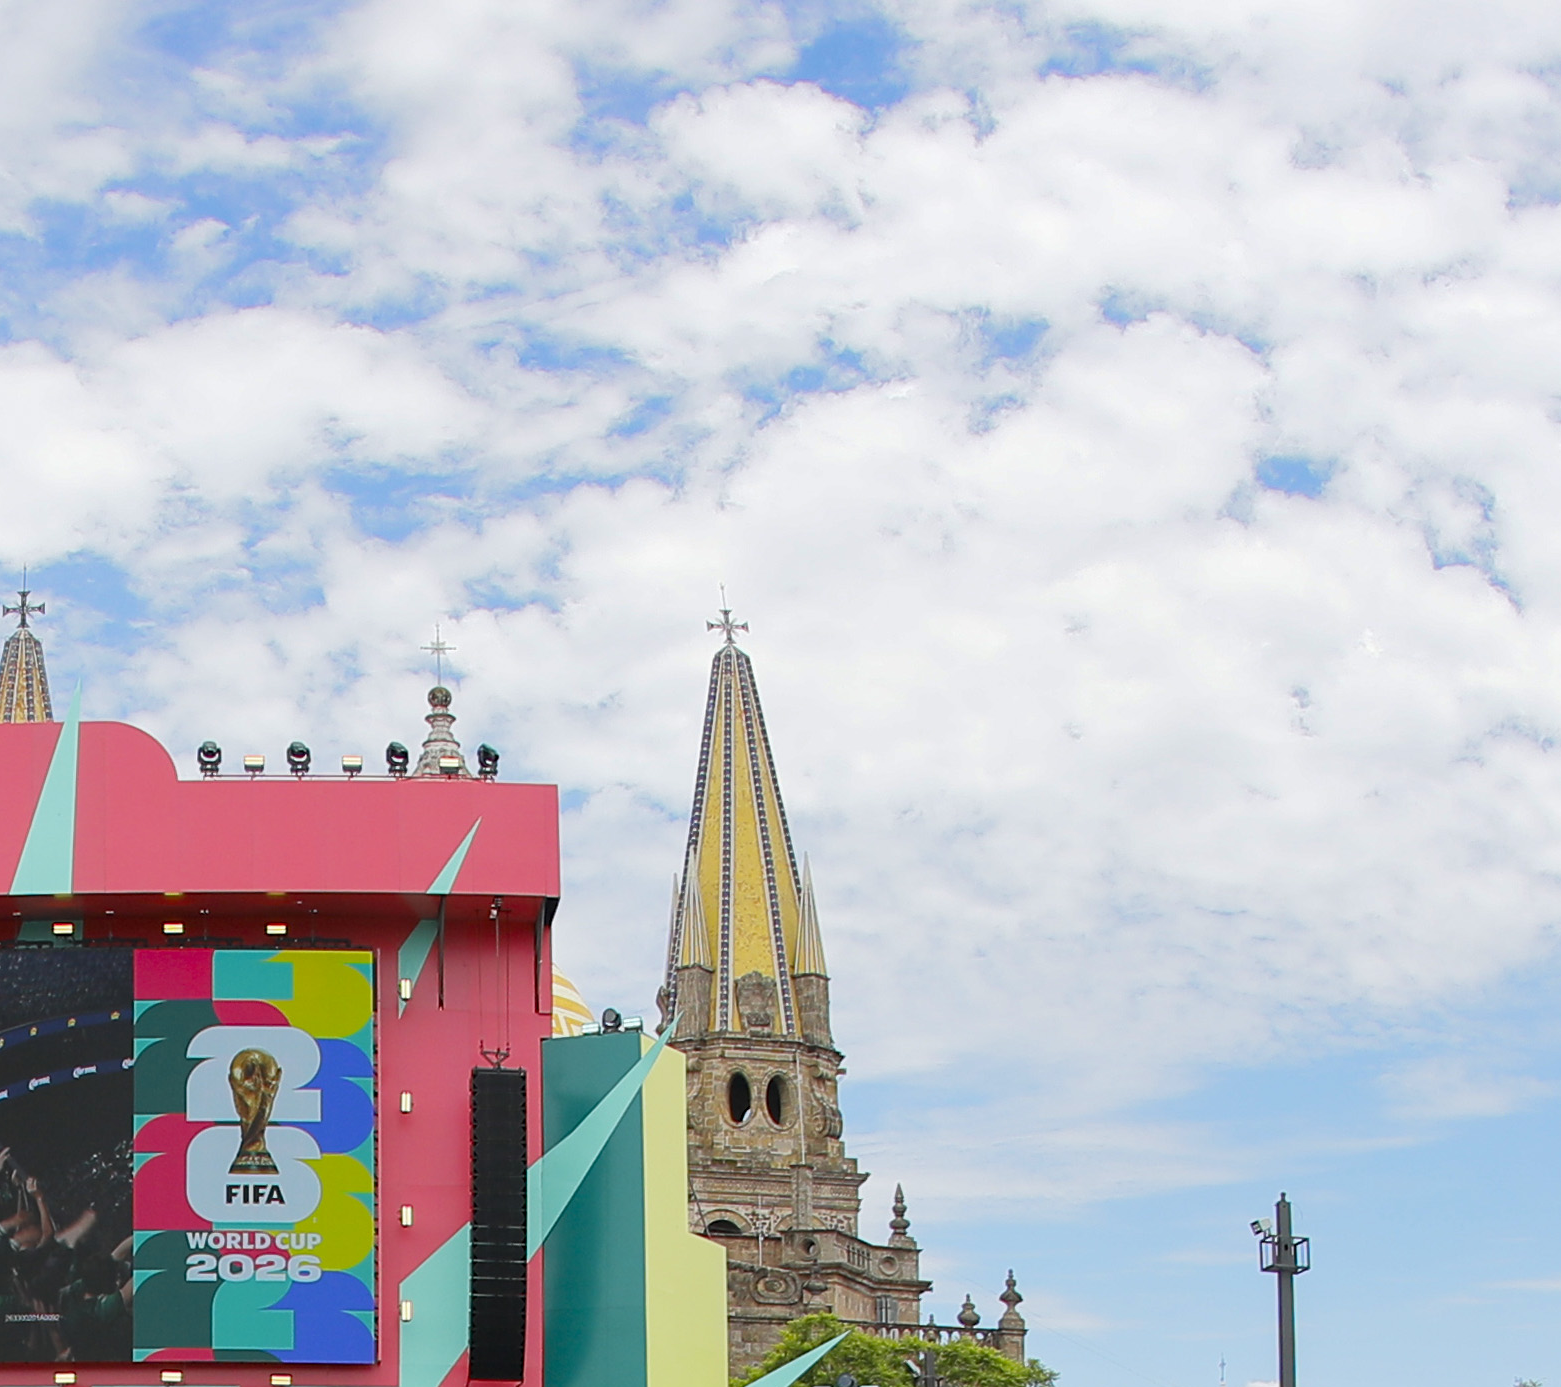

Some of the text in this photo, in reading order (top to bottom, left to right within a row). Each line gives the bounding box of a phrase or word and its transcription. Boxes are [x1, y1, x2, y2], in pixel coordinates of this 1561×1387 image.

[225, 1184, 286, 1205] FIFA
[186, 1232, 322, 1250] WORLD CUP
[186, 1254, 322, 1283] 2026
